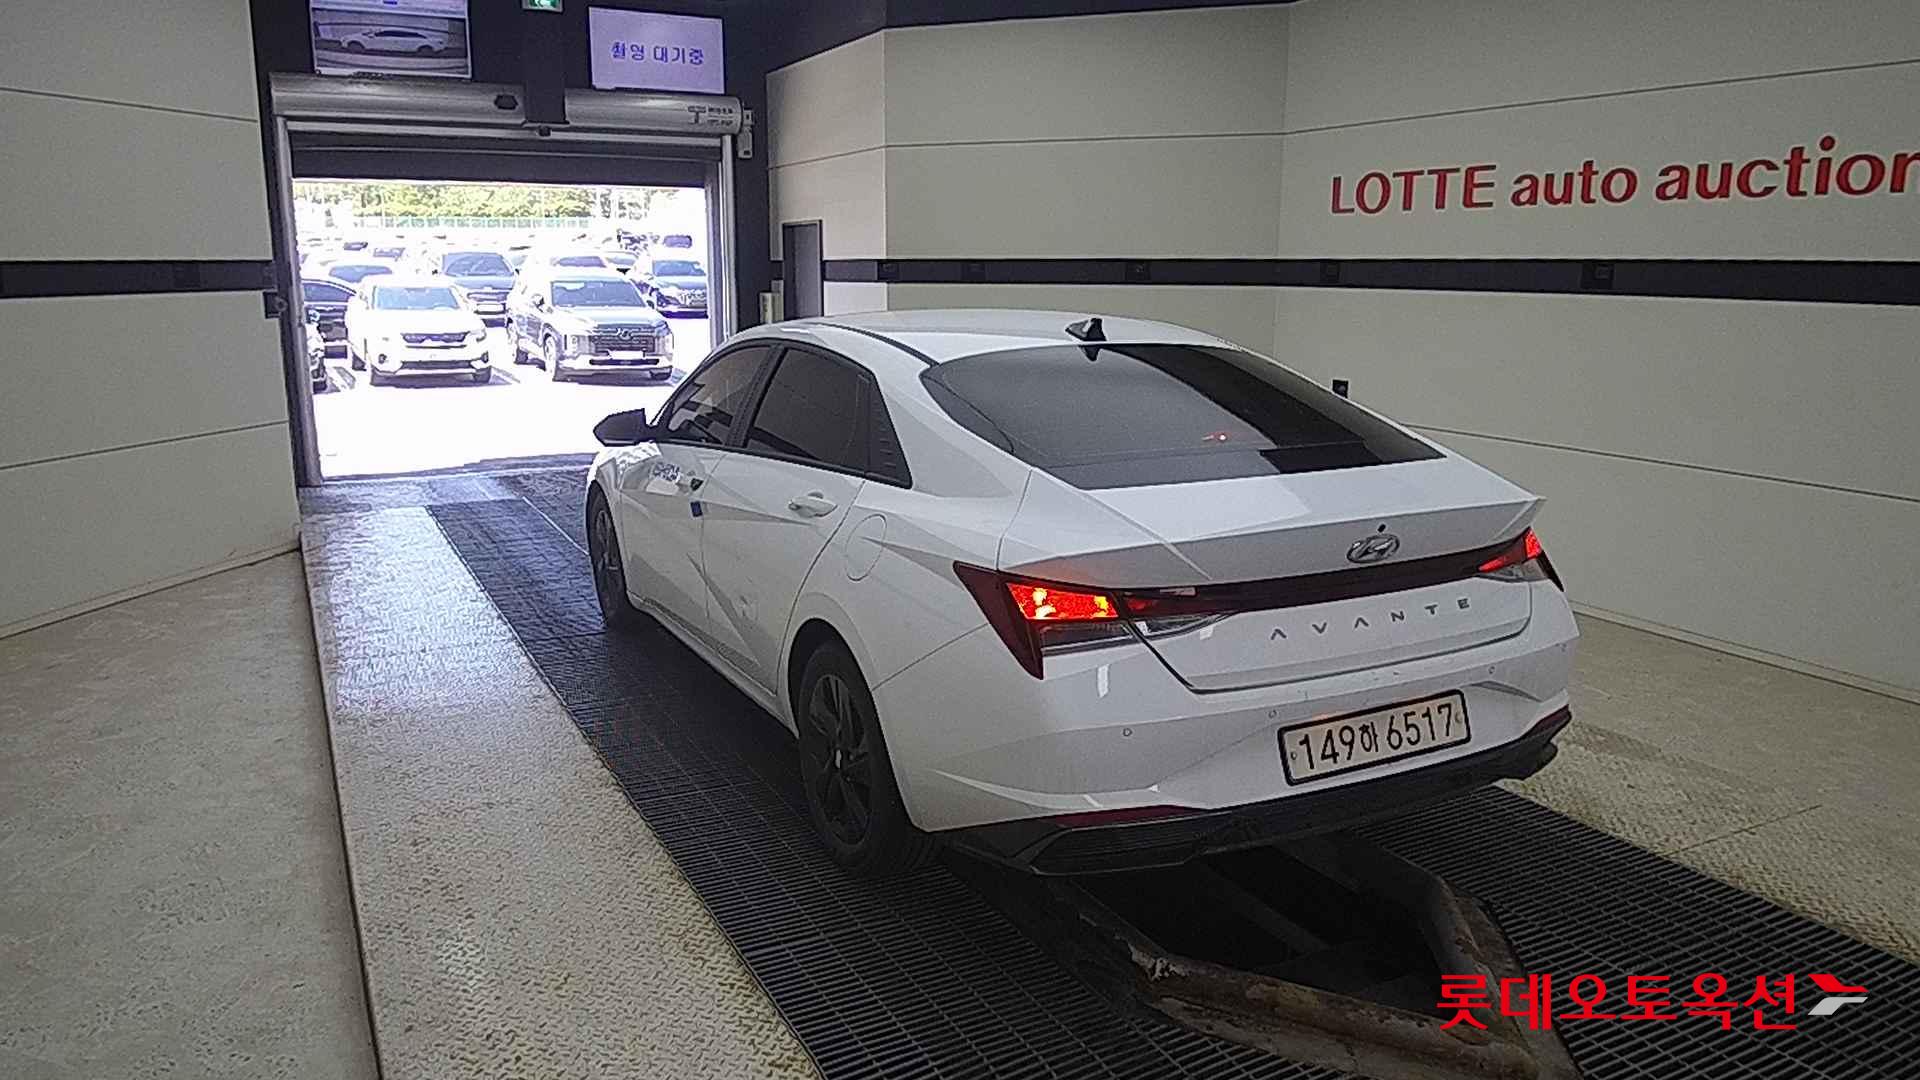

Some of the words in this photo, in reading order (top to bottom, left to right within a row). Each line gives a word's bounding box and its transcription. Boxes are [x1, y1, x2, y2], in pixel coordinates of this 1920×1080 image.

[653, 46, 704, 65] 대기중
[1331, 164, 1497, 215] LOTTE
[1510, 160, 1638, 206] auto
[1270, 598, 1470, 640] AVANTE
